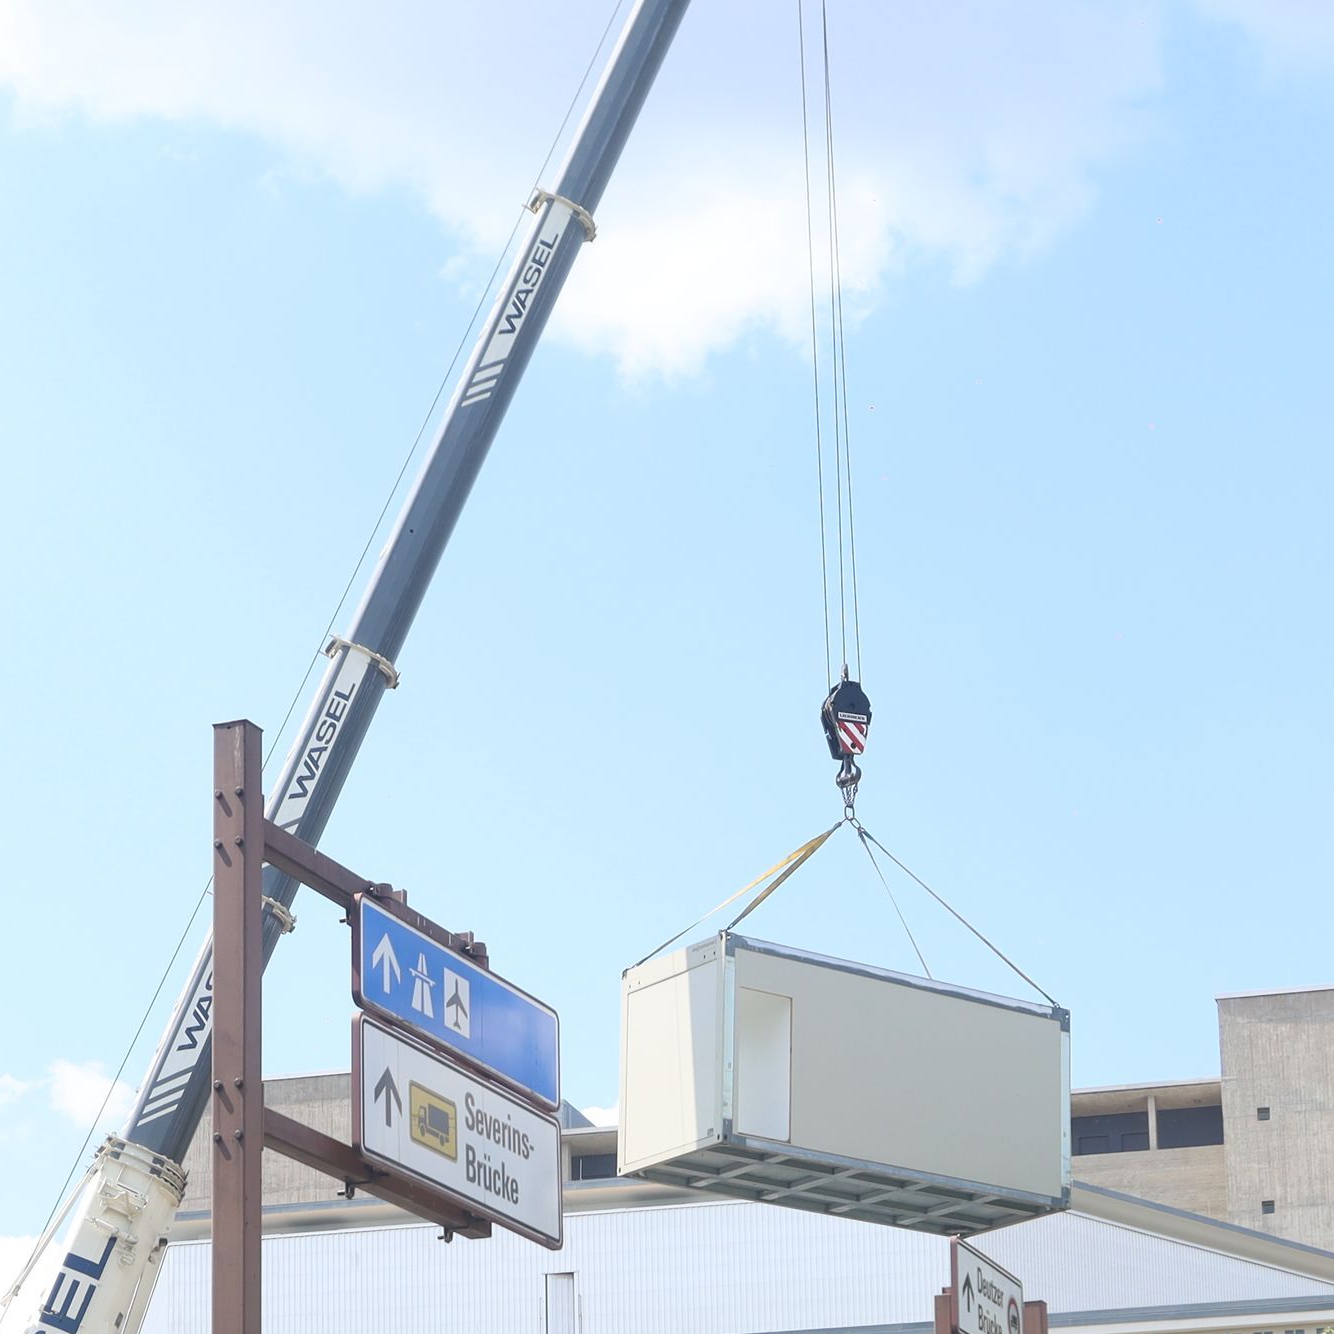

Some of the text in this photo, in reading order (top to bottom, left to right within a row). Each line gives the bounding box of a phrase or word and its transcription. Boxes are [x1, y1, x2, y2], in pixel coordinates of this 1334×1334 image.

[498, 232, 560, 336] WASEL
[287, 682, 356, 800] WASEL
[464, 1091, 535, 1161] Severins-
[465, 1142, 519, 1205] Brücke
[977, 1266, 1004, 1309] Deutzer
